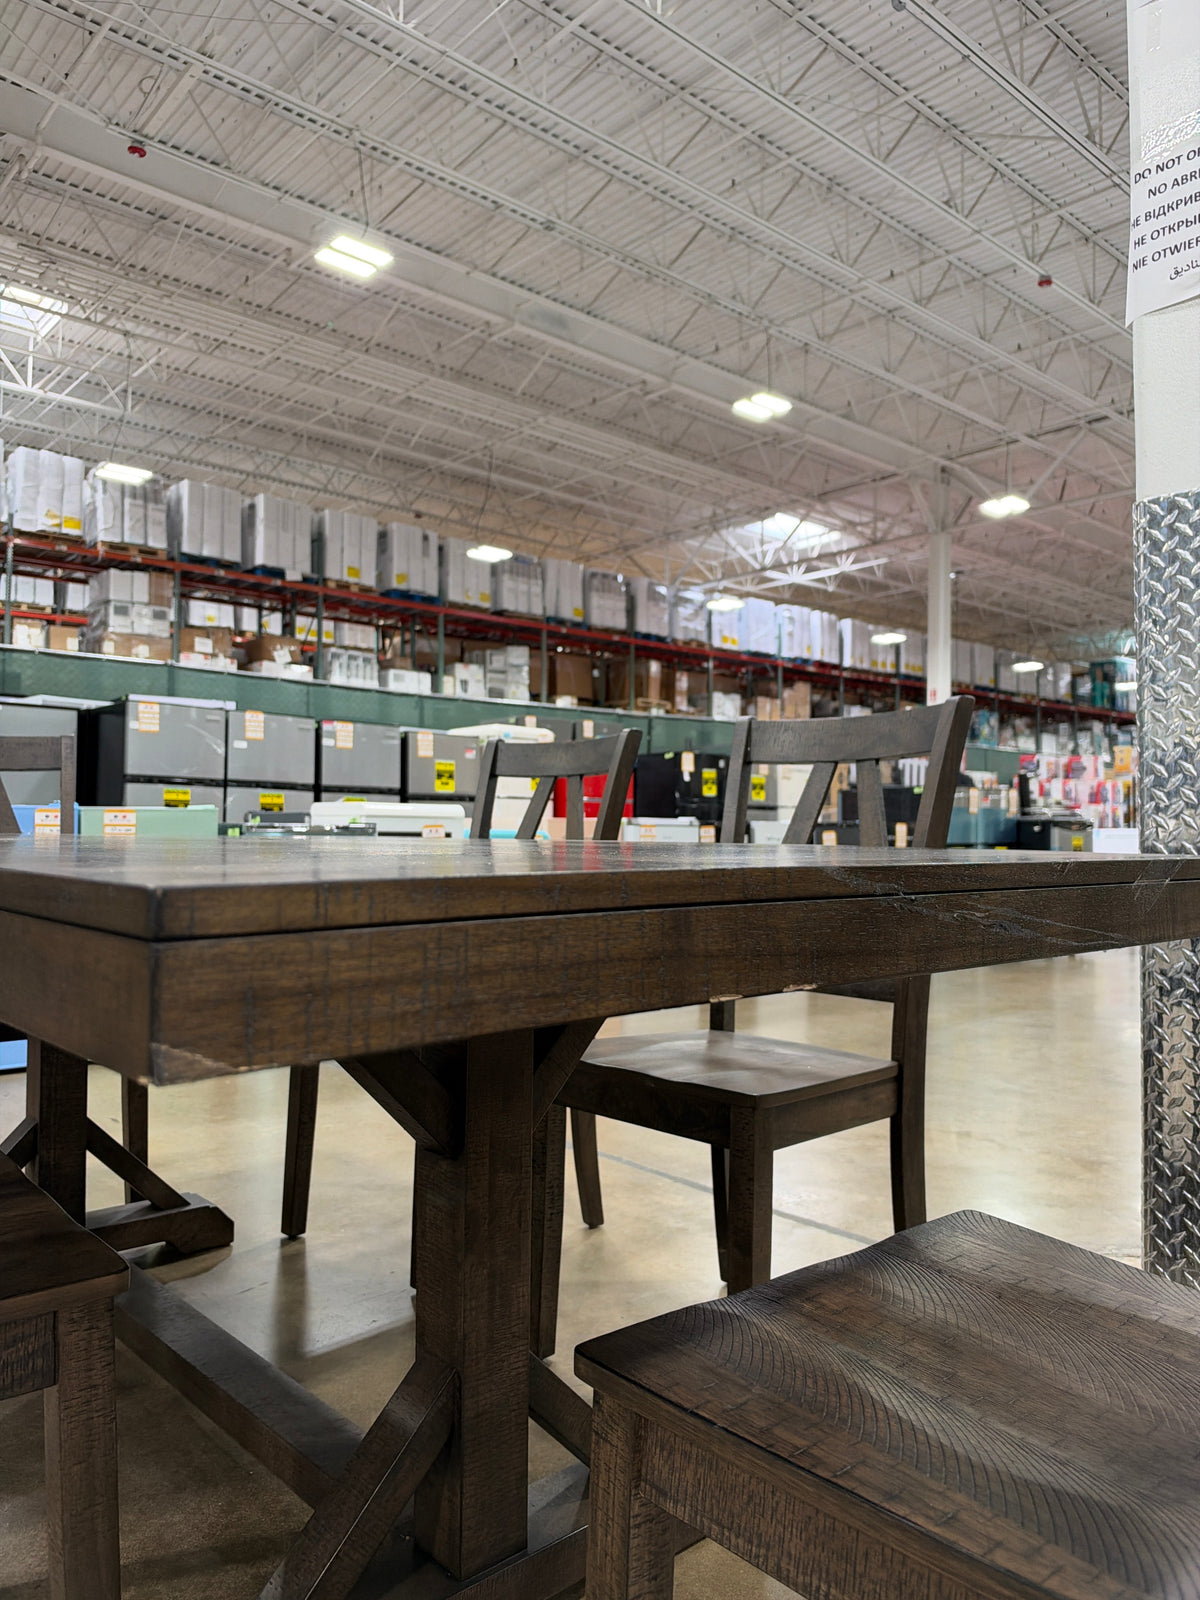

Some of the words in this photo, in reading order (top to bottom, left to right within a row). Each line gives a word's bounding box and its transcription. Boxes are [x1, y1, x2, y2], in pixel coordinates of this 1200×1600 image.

[1134, 168, 1152, 184] DO
[1156, 154, 1183, 174] NOT
[1148, 183, 1167, 199] NO
[1134, 234, 1147, 250] НЕ
[1150, 213, 1200, 241] ОТКРЫ
[1132, 255, 1148, 273] NIE
